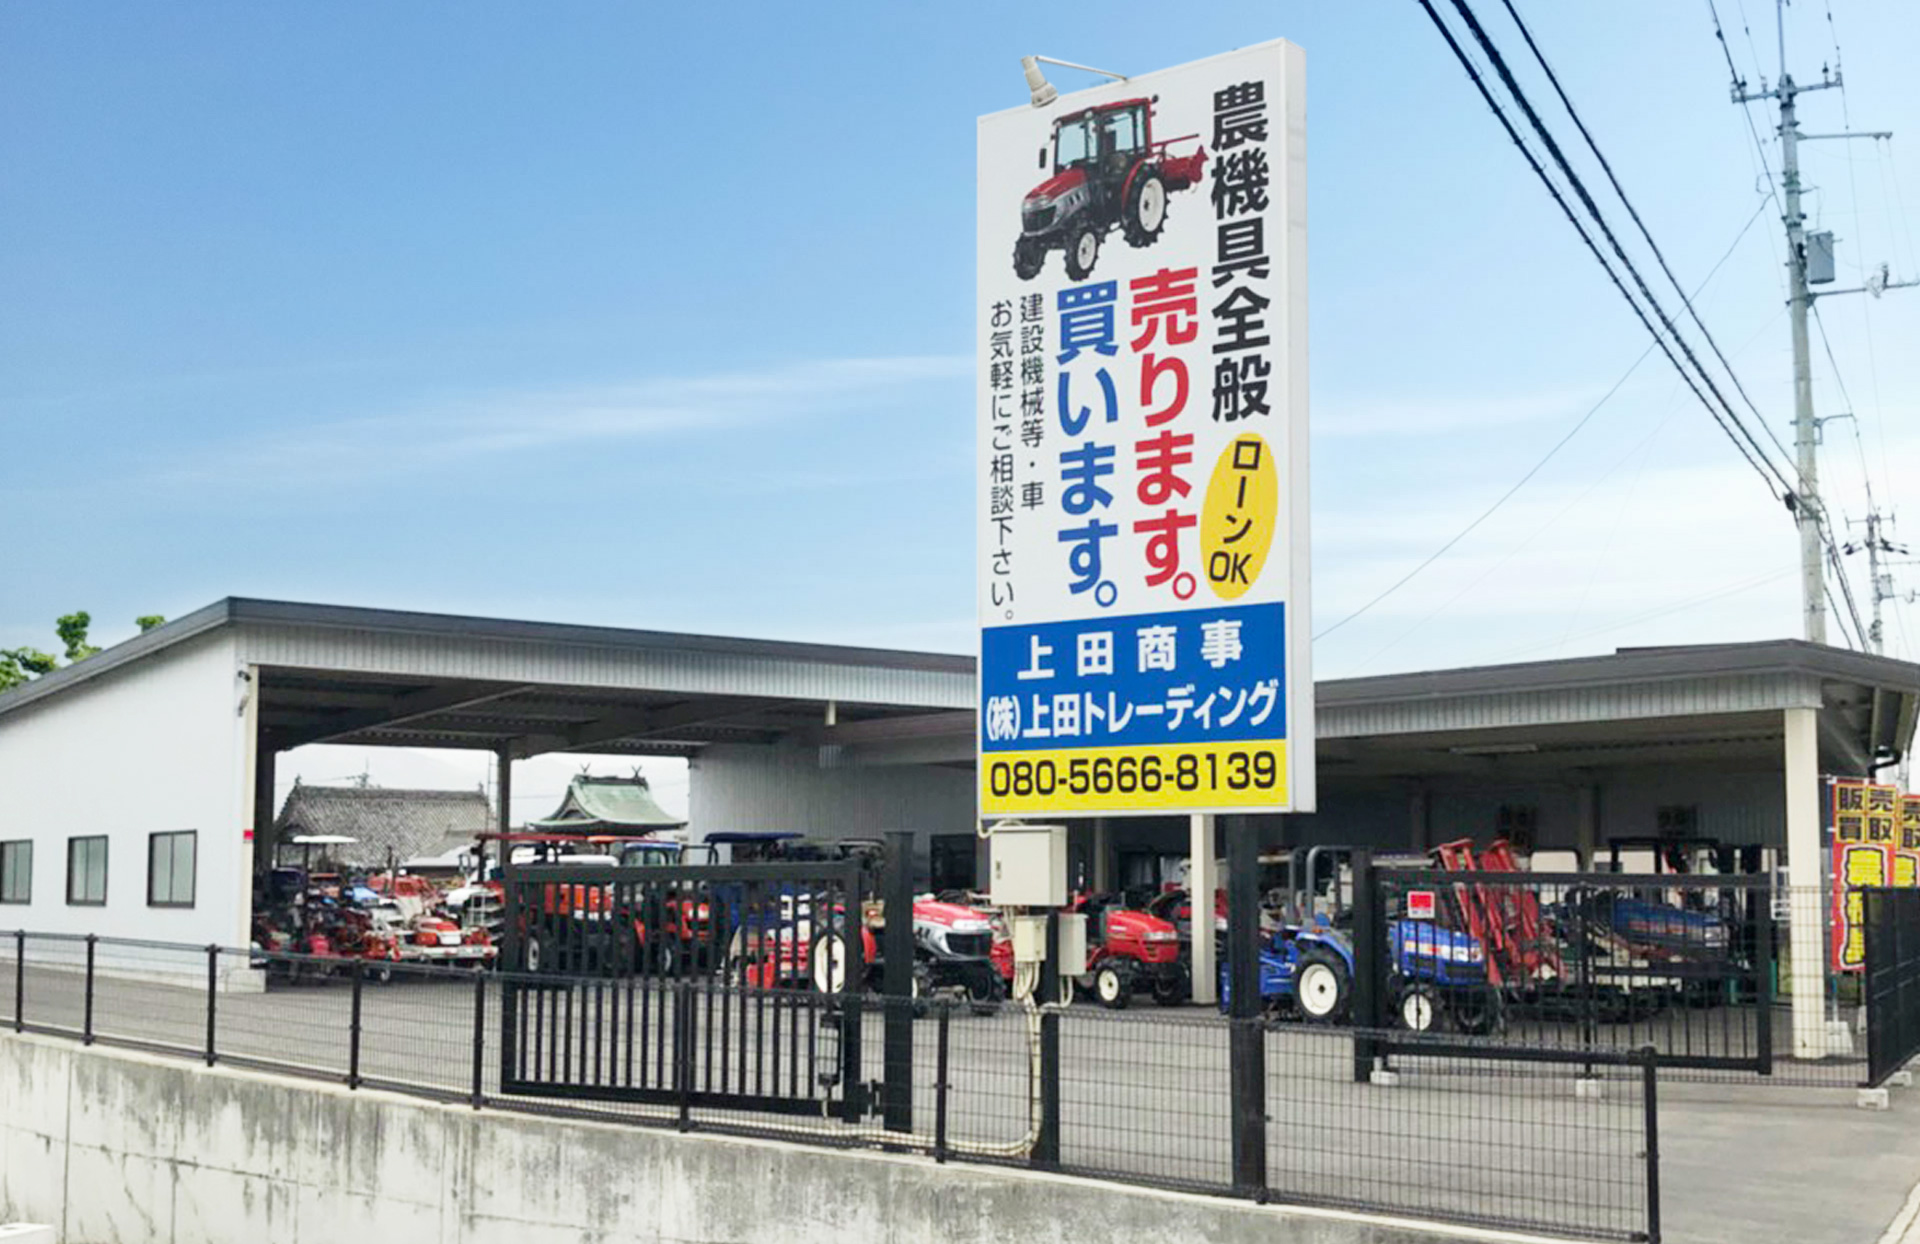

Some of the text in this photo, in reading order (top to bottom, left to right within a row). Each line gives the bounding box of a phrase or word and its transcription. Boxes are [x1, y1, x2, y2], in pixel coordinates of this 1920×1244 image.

[1210, 80, 1271, 422] 農機具全般
[990, 299, 1014, 620] お気軽にご相談下さい。
[1019, 293, 1044, 510] 建設機械等・車
[1056, 279, 1119, 608] 買います。
[1129, 266, 1199, 601] 売ります。
[1223, 440, 1261, 544] ローン
[1017, 619, 1243, 680] 上田商事
[1208, 550, 1252, 585] OK
[990, 751, 1276, 797] 080-5666-8139
